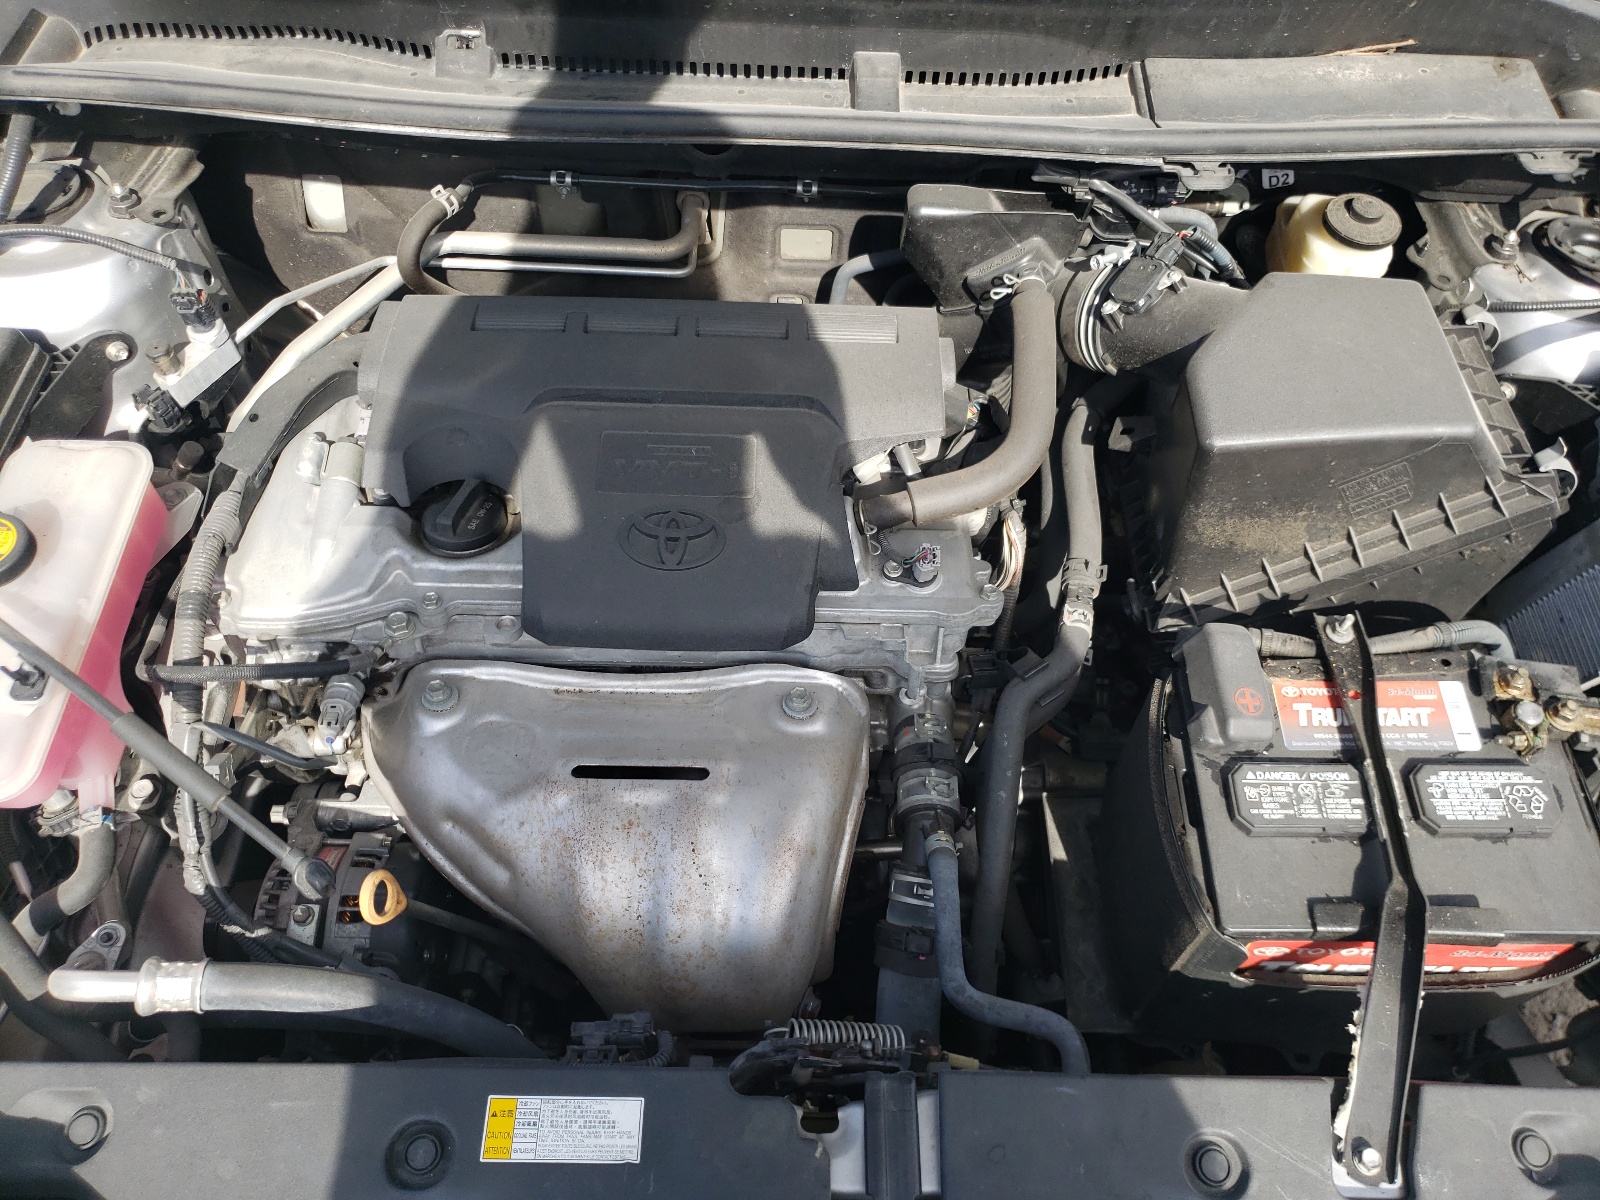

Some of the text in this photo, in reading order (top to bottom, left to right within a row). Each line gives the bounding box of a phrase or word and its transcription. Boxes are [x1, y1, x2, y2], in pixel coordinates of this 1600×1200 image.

[1269, 173, 1289, 187] D2
[467, 519, 480, 530] SAE
[1300, 687, 1340, 696] TOYOT
[1292, 702, 1431, 728] TRUTART
[1256, 771, 1300, 780] DANGER
[1309, 772, 1350, 781] POISON
[1296, 948, 1374, 956] TOYOT
[485, 1147, 510, 1155] ATTENTION
